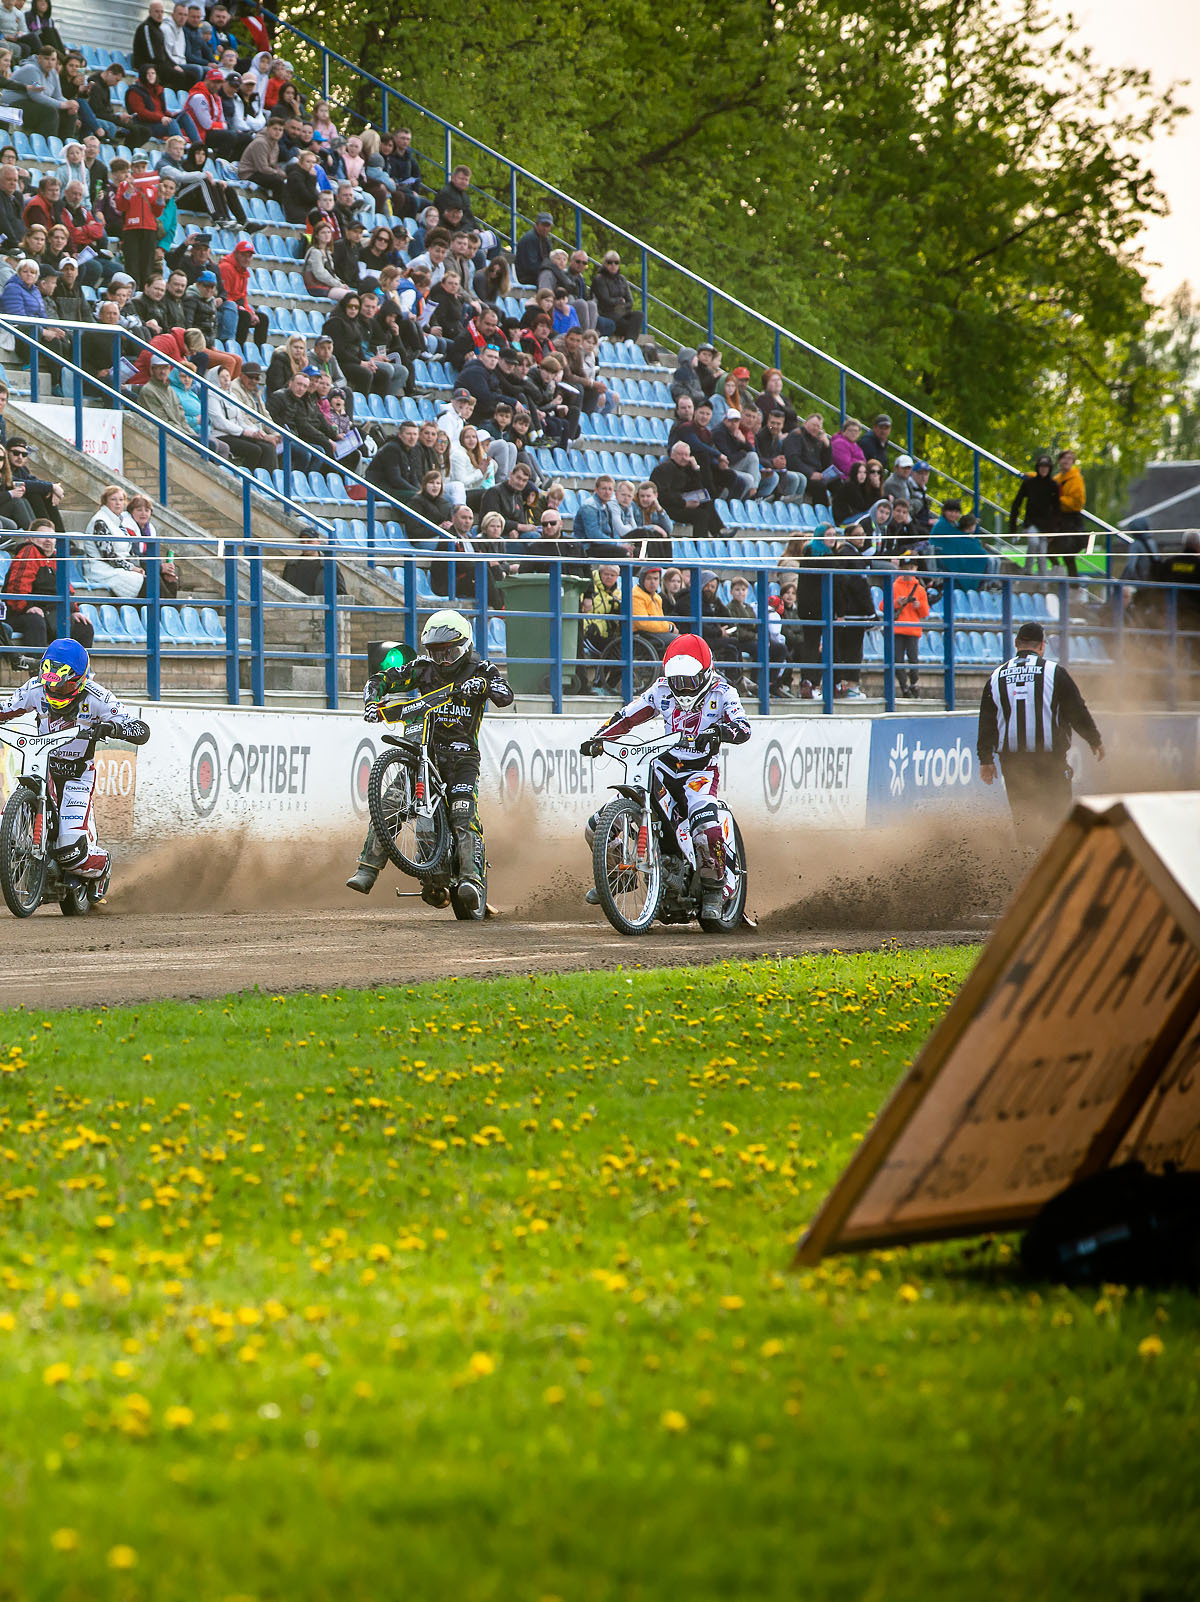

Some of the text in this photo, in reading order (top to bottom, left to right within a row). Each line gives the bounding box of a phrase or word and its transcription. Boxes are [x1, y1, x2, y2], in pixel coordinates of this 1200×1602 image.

[1000, 665, 1043, 678] KIEROWNIK
[1006, 673, 1035, 684] STARTU
[29, 738, 59, 746] OPTIBET
[631, 746, 661, 755] OPTIBET
[228, 743, 311, 794] OPTIBET
[531, 748, 595, 795] OPTIBET
[790, 746, 852, 790] OPTIBET
[912, 736, 972, 787] trodo
